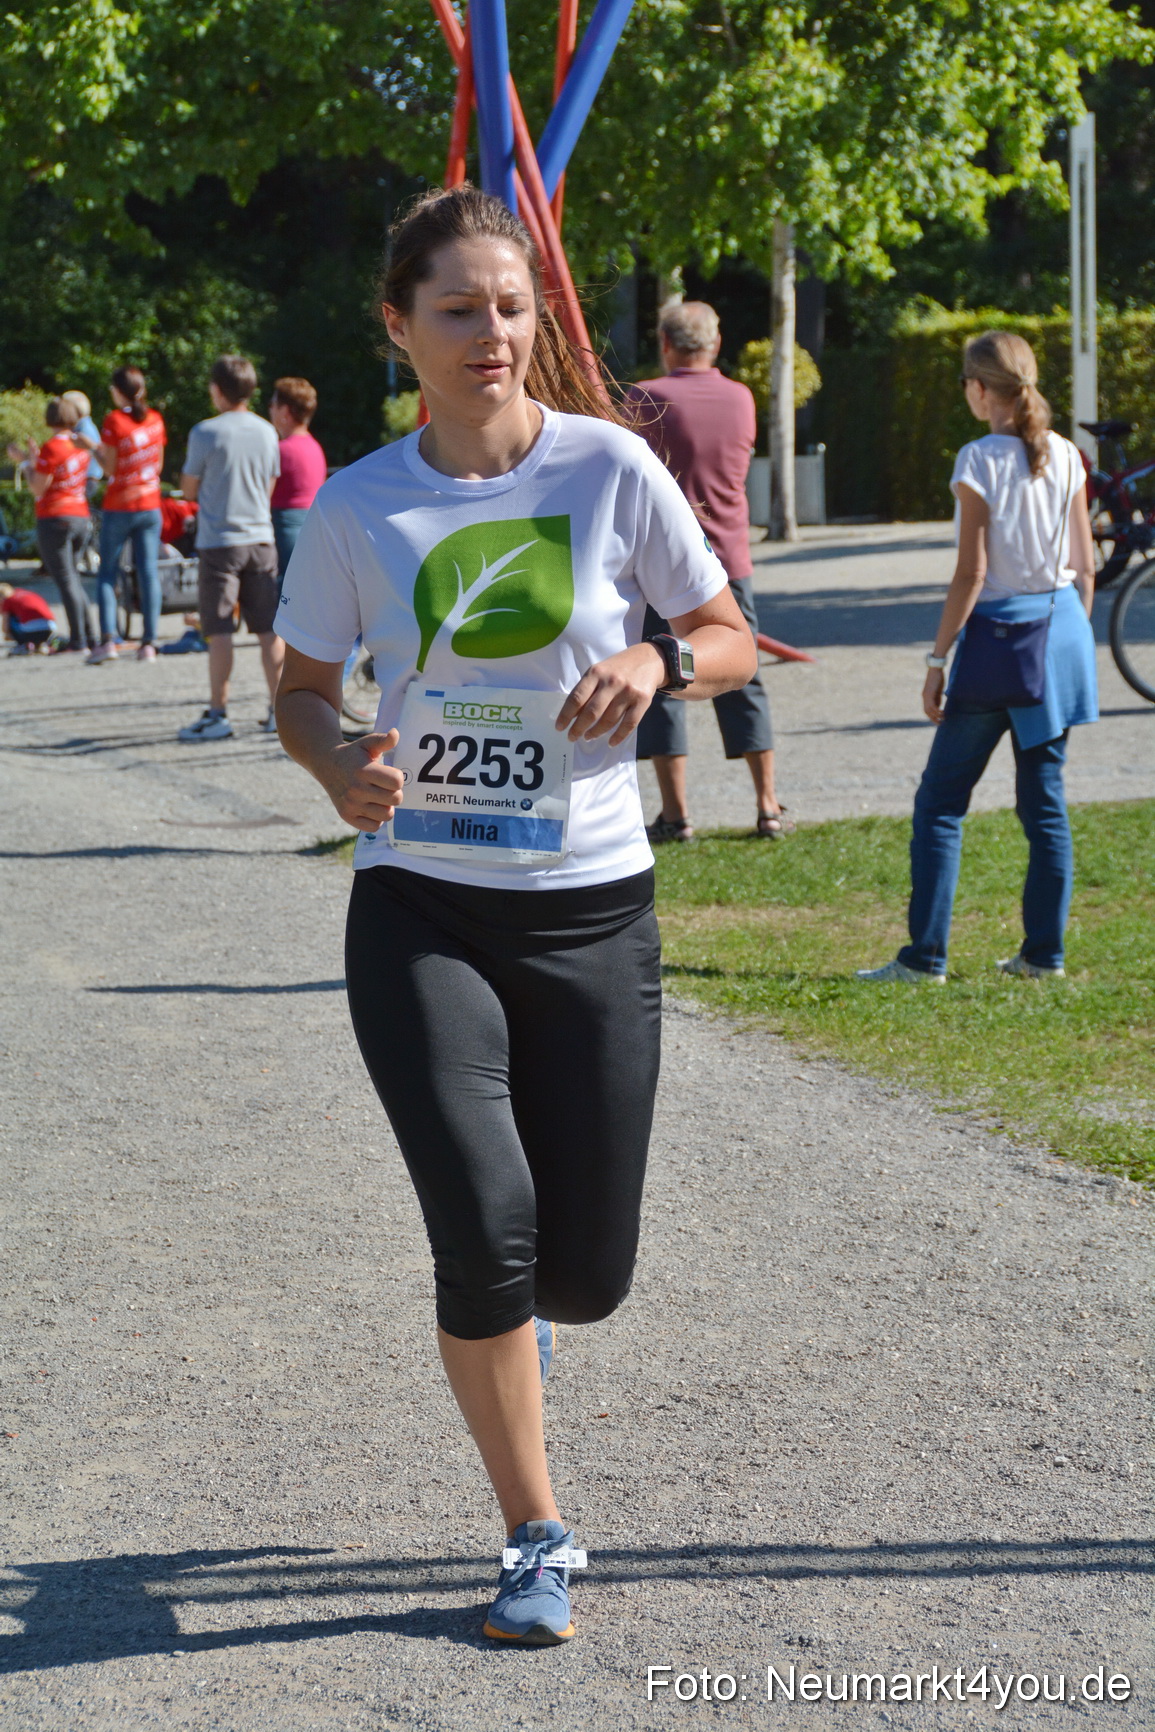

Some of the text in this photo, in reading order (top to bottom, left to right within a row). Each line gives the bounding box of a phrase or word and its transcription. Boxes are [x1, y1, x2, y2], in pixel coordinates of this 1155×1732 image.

[443, 702, 523, 724] BOCK
[443, 720, 466, 728] inspired
[417, 733, 545, 791] 2253
[426, 793, 516, 808] PARTL Neumarkt
[451, 818, 498, 842] Nina
